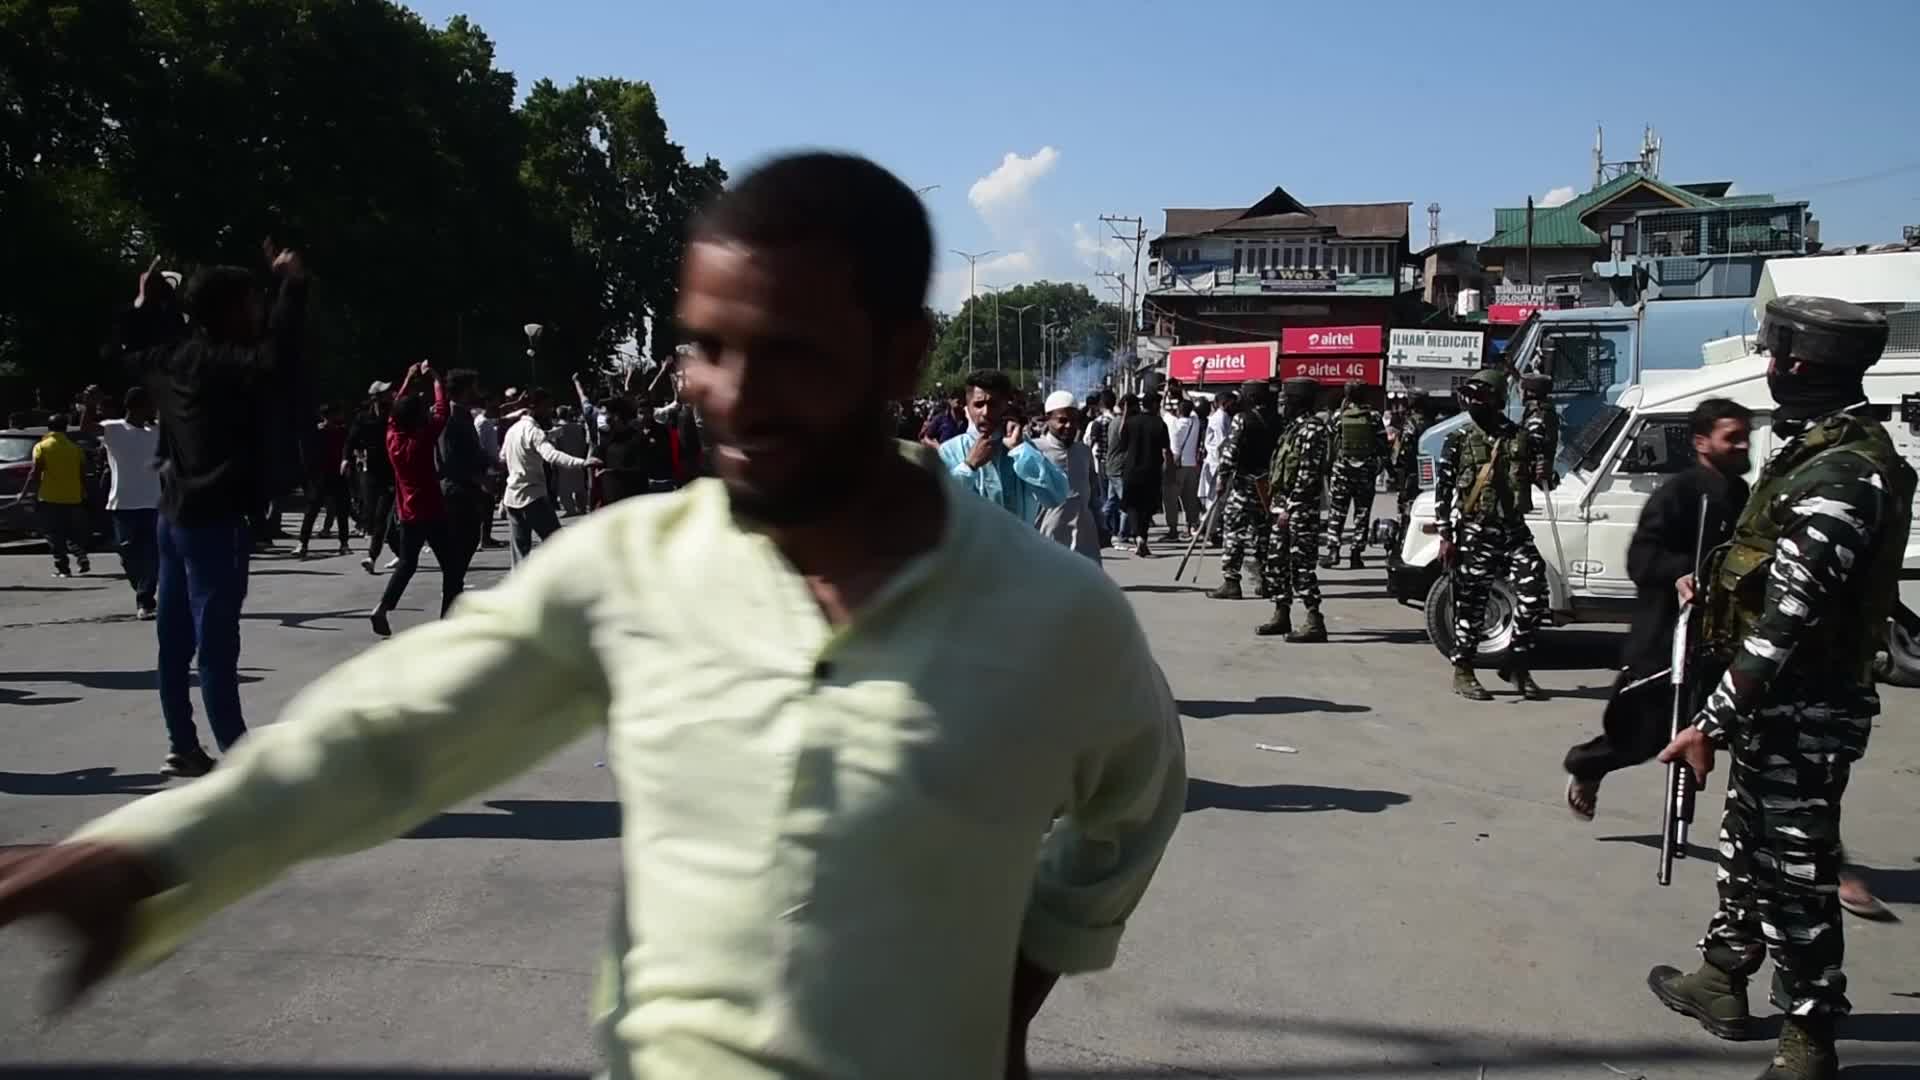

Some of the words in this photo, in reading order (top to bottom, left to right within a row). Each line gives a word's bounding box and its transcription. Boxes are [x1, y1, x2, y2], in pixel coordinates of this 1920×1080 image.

[1280, 271, 1314, 280] Web
[1317, 271, 1329, 279] X
[1321, 332, 1354, 345] airtel
[1393, 333, 1425, 347] ILHAM
[1427, 335, 1479, 348] MEDICATE
[1206, 354, 1246, 369] airtel
[1308, 363, 1341, 376] airtel
[1346, 363, 1364, 376] 4G
